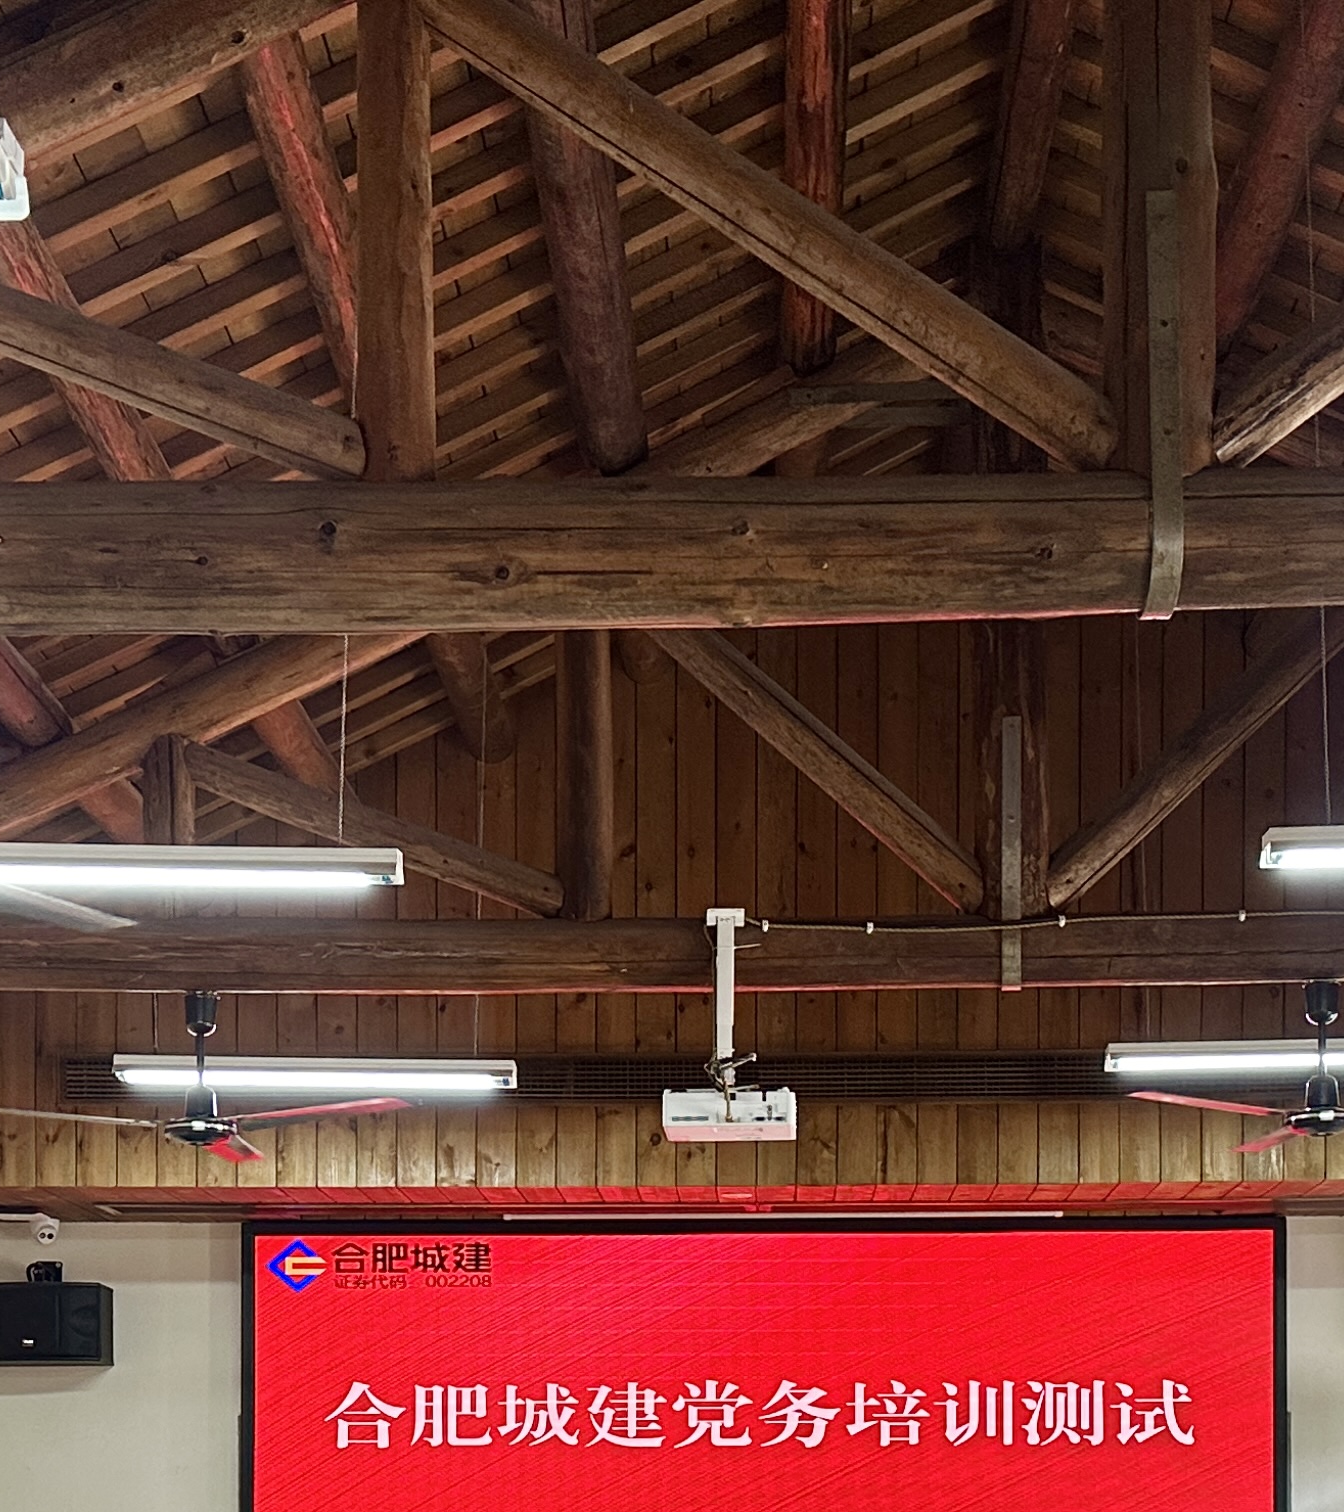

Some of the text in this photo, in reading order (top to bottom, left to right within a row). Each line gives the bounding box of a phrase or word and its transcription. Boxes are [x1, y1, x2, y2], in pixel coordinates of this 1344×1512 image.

[331, 1242, 492, 1274] 合肥城建
[334, 1275, 492, 1290] 证券代码 002208
[324, 1379, 1196, 1449] 合肥城建党务培训测试
